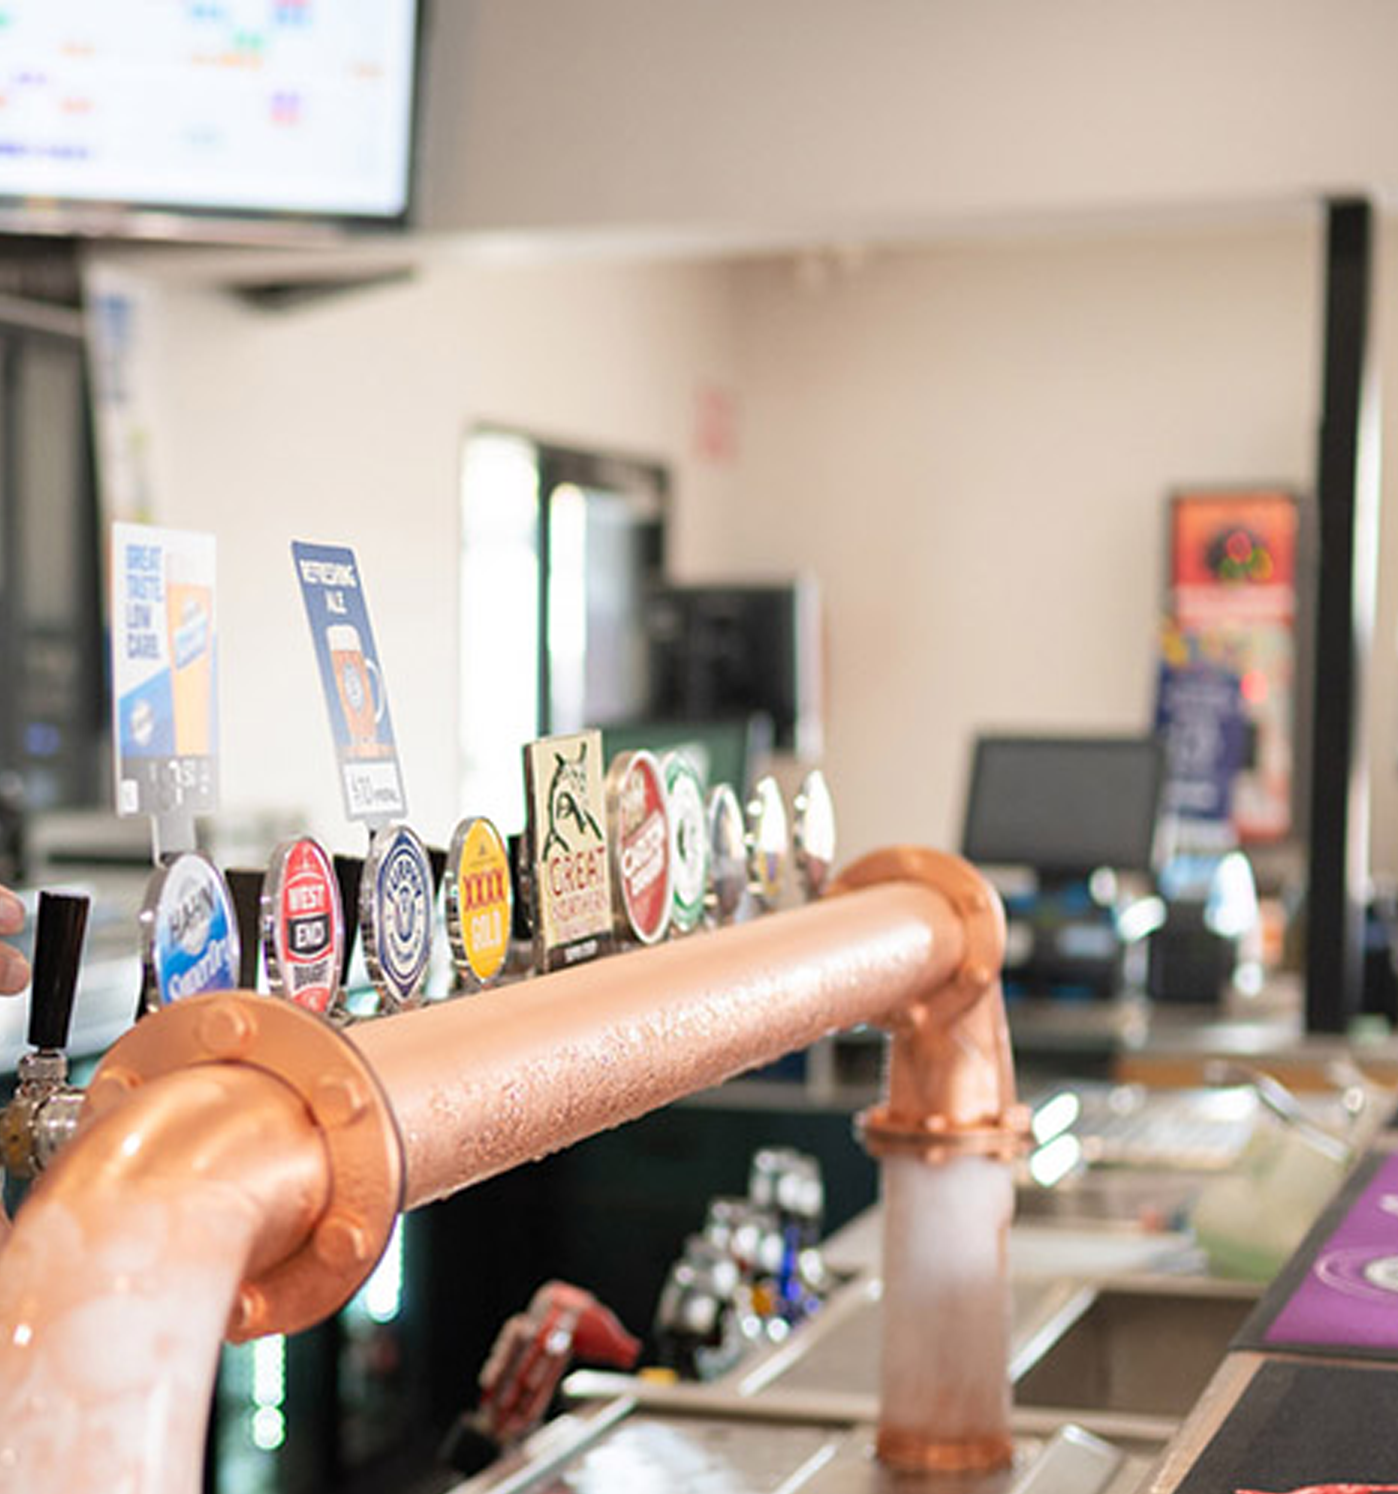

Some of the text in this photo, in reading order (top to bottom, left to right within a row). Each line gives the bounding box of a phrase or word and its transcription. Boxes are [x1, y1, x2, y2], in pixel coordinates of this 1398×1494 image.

[126, 544, 163, 571] GREAT
[126, 574, 164, 602] TASTE
[324, 590, 348, 615] ALE
[126, 602, 151, 629] LOW
[549, 846, 606, 897] GREAT
[288, 884, 326, 914] WEST
[463, 866, 506, 914] XXXX
[295, 920, 326, 950] END
[471, 910, 501, 954] GOLD
